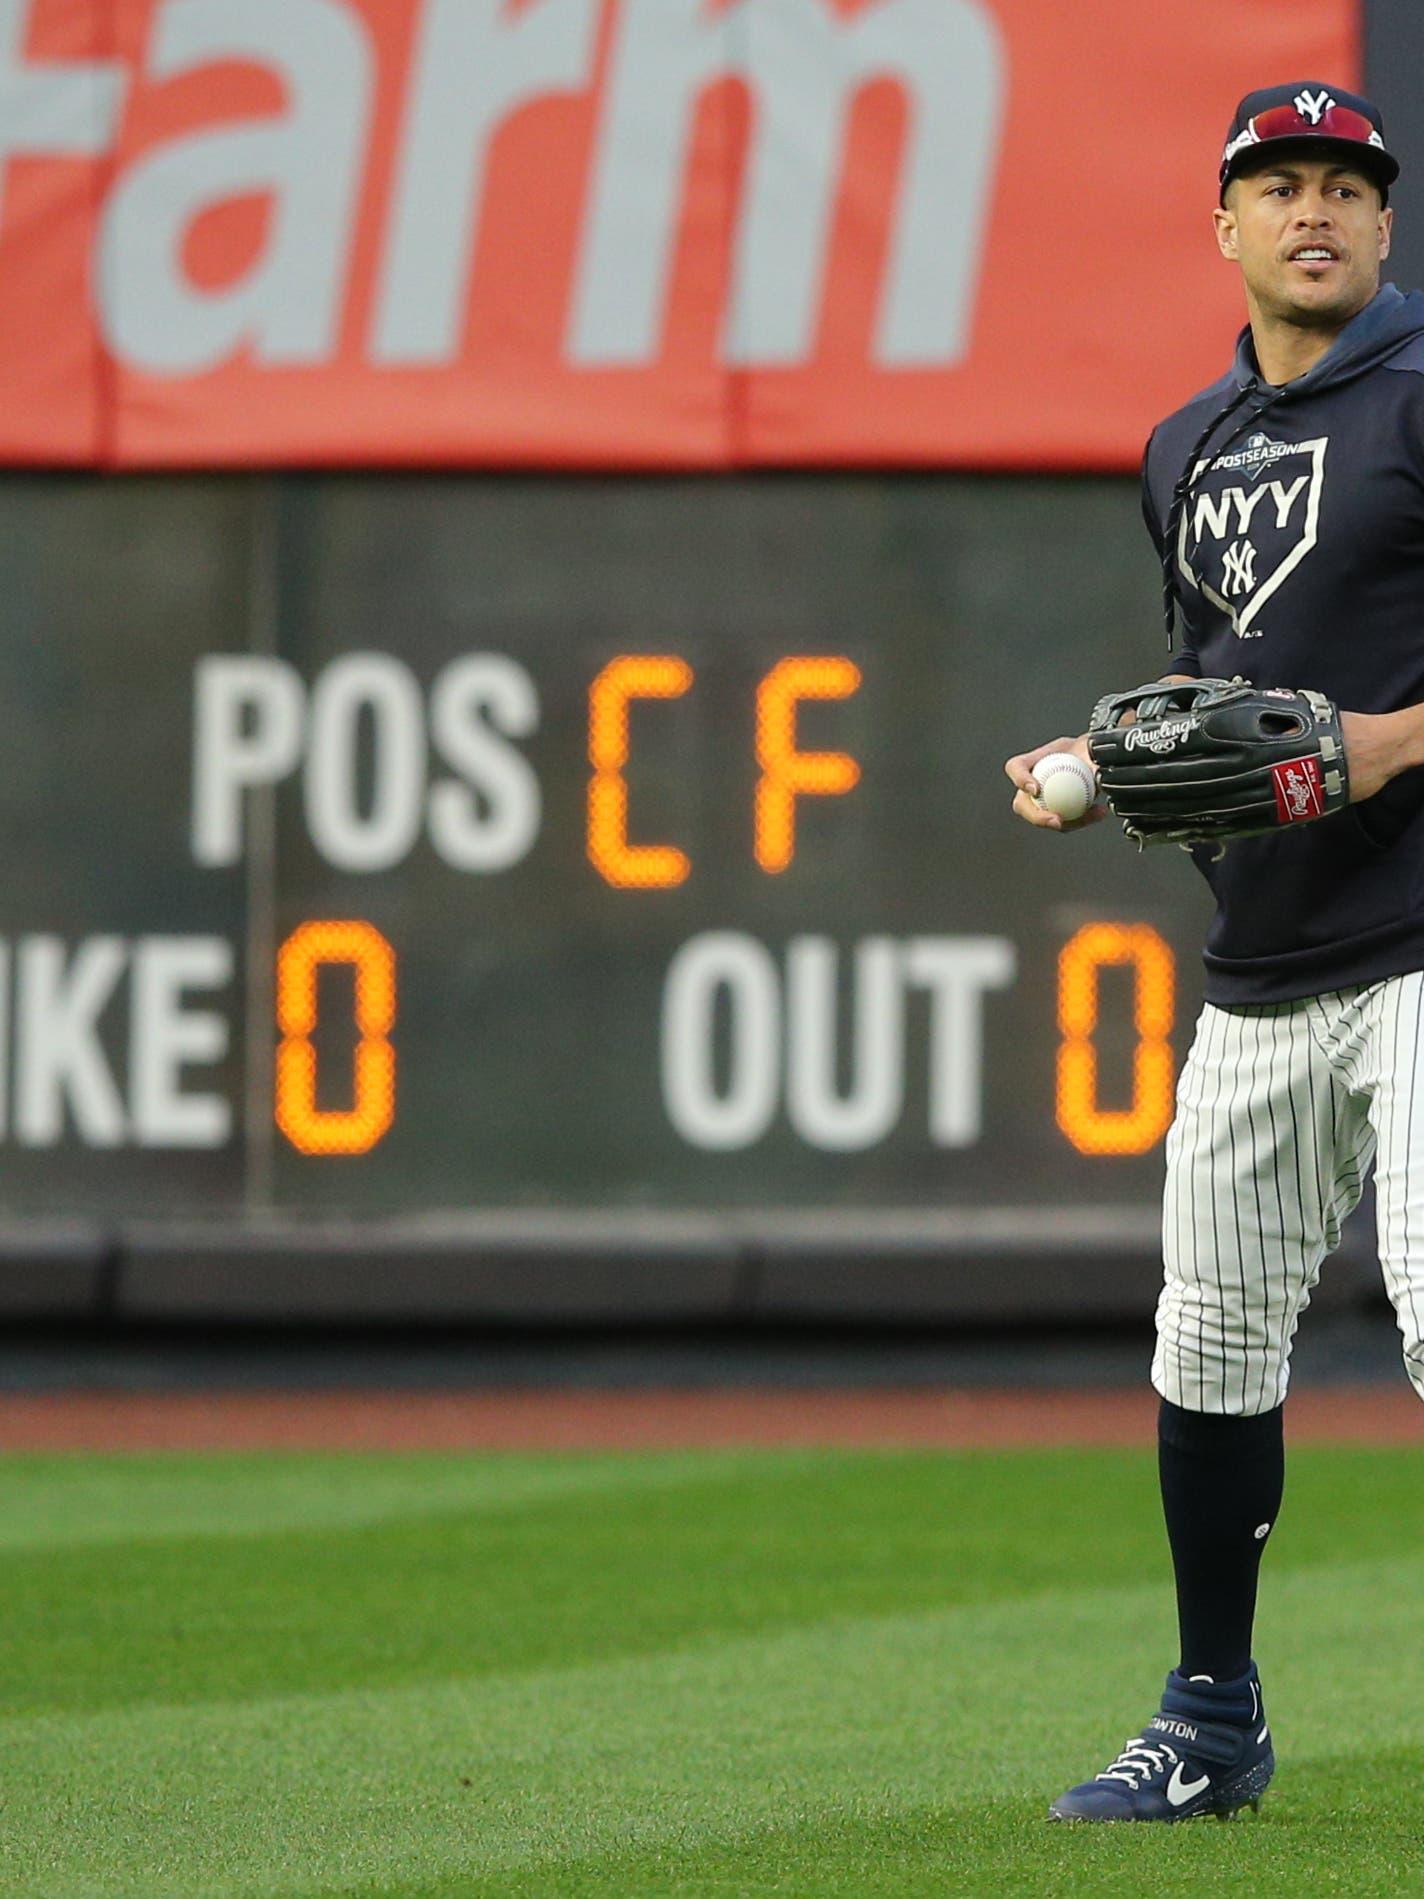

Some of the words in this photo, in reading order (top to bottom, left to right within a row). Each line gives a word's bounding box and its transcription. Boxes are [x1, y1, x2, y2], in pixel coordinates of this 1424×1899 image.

[1293, 88, 1337, 126] NY
[1214, 443, 1299, 469] POSTSEASON
[1194, 475, 1310, 543] NYY
[1221, 539, 1258, 598] NY
[191, 652, 542, 874] POS
[1124, 718, 1200, 752] Rawlings
[0, 934, 232, 1148] KE
[274, 920, 396, 1156] 0
[661, 932, 1016, 1152] OUT
[1055, 922, 1175, 1157] 0
